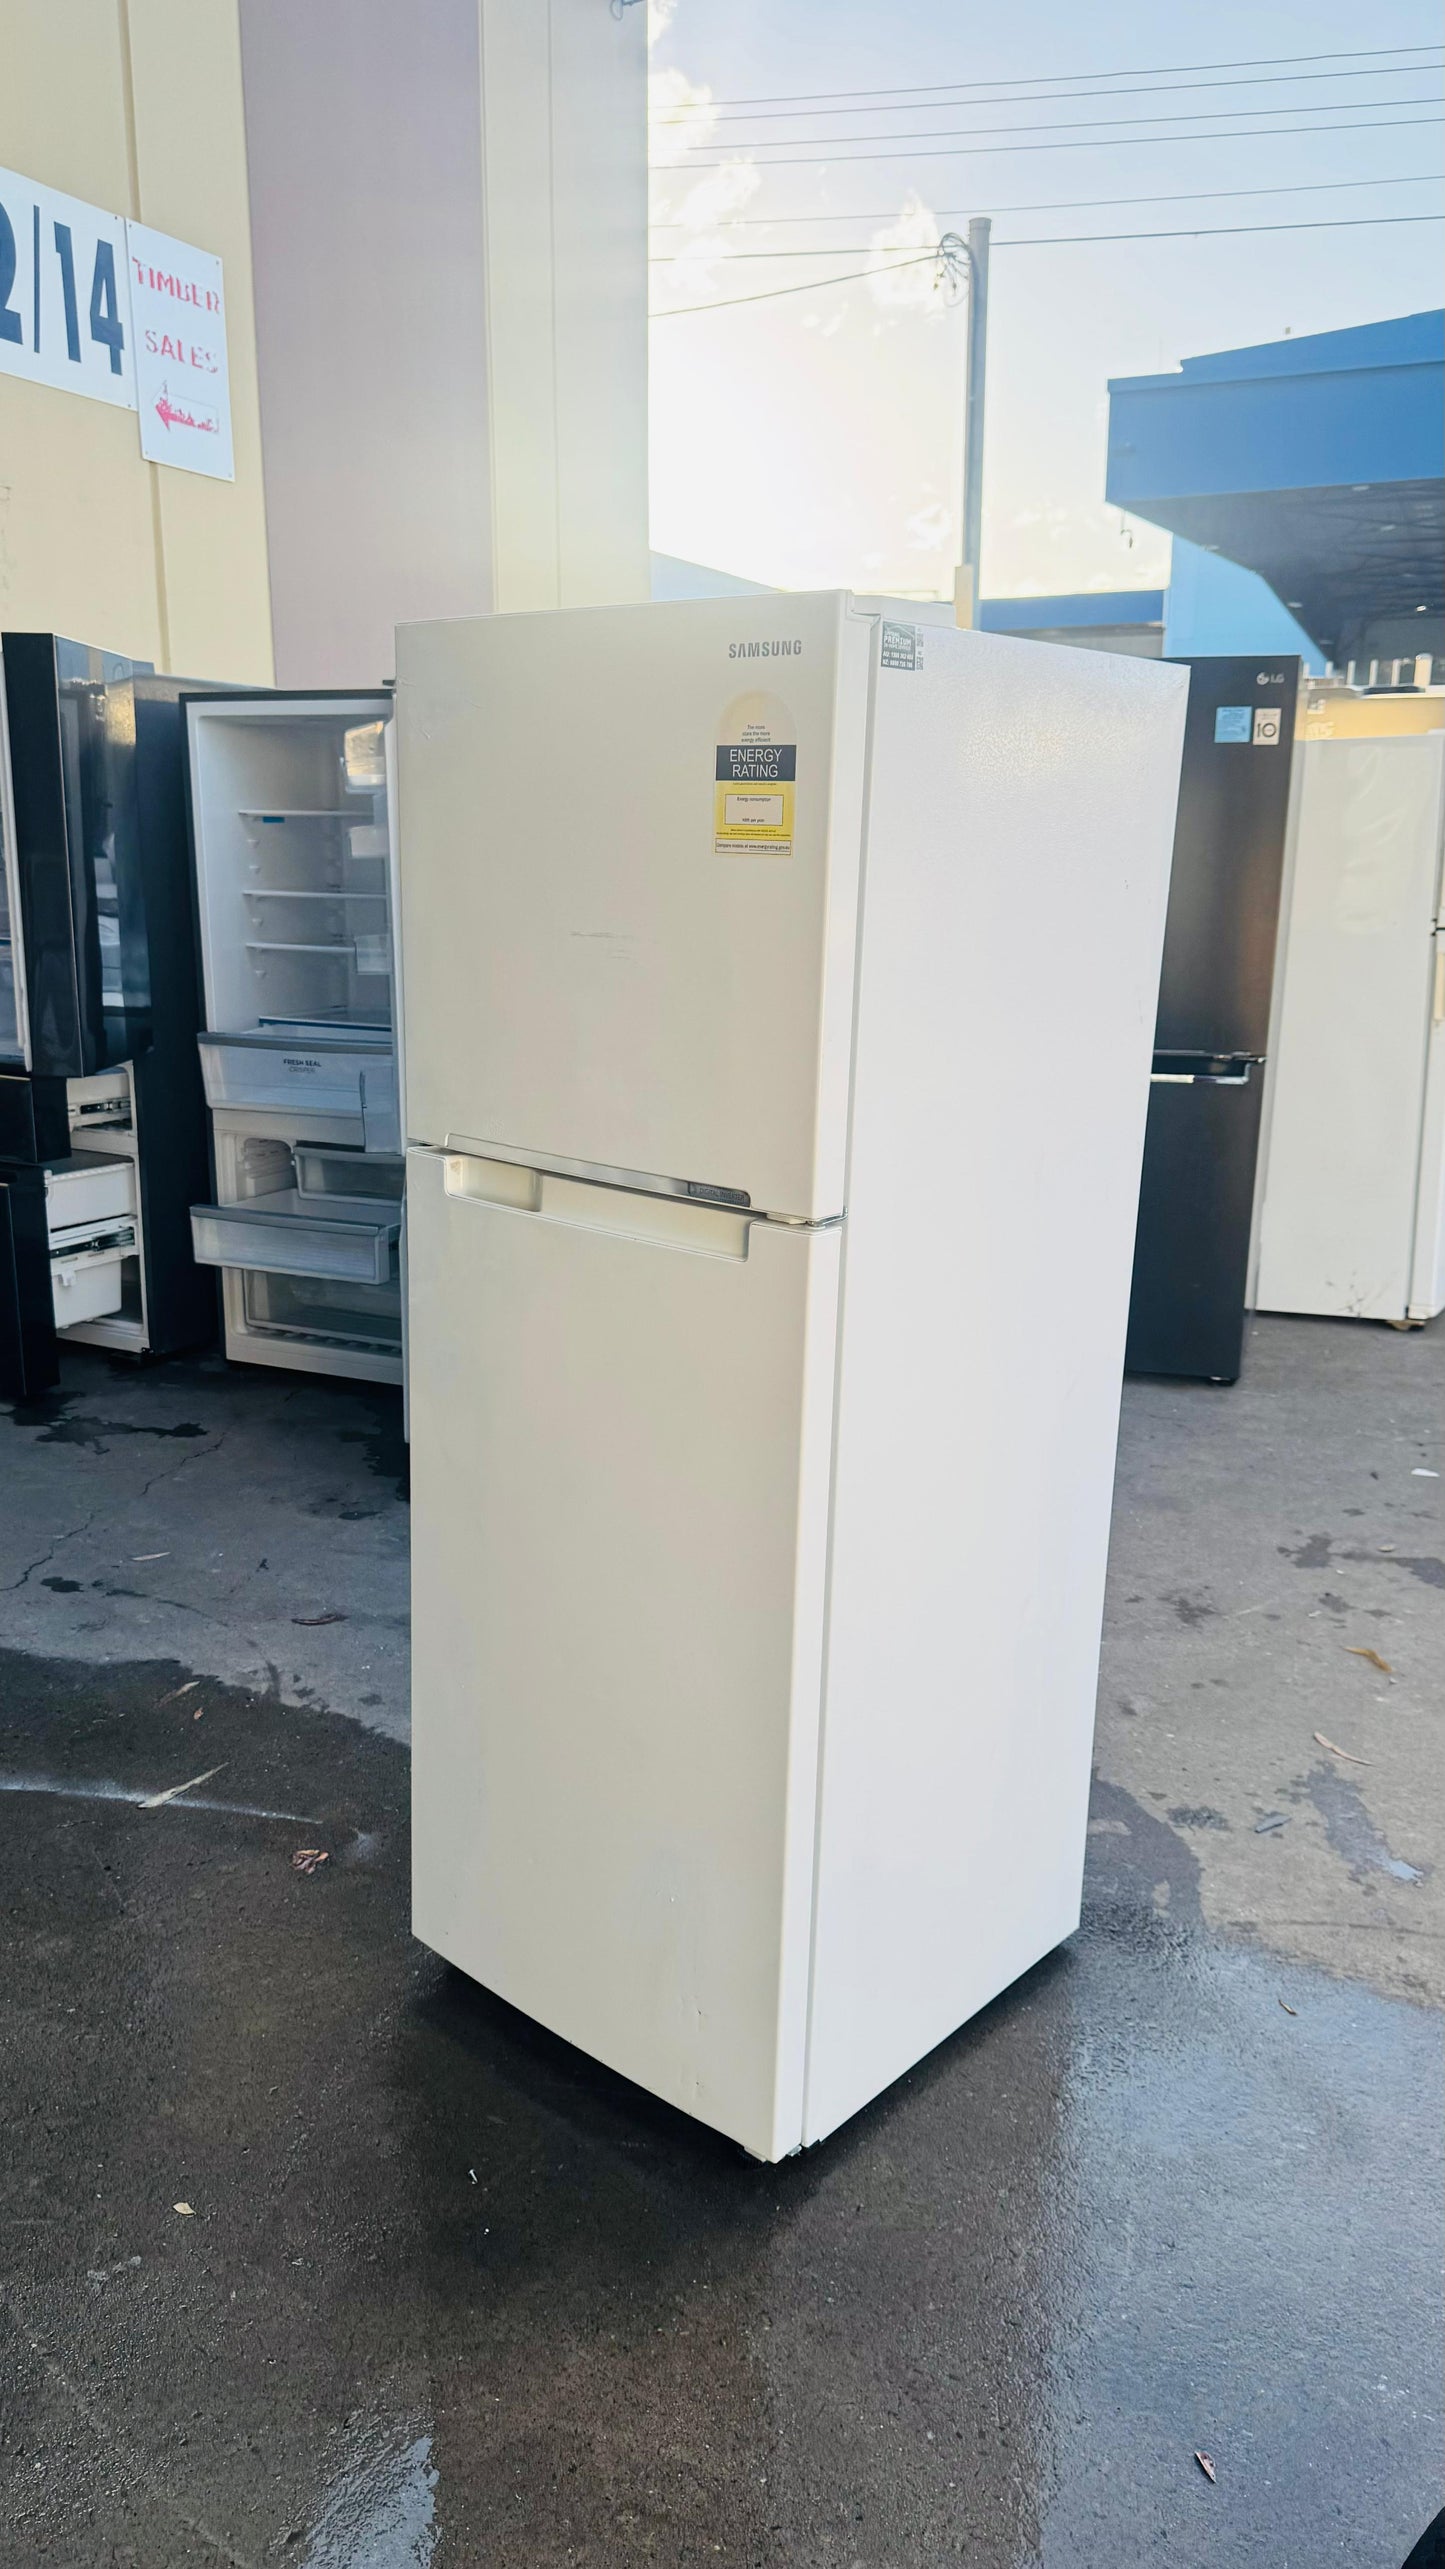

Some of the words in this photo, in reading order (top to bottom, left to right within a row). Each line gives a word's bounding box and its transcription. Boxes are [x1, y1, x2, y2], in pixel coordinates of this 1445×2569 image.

[131, 256, 220, 315] TIMBER
[145, 330, 218, 374] SALES
[728, 640, 802, 659] SAMSUNG
[1271, 673, 1285, 683] LG
[729, 748, 783, 763] ENERGY
[732, 763, 778, 778] RATING
[283, 1058, 304, 1066] FRESH
